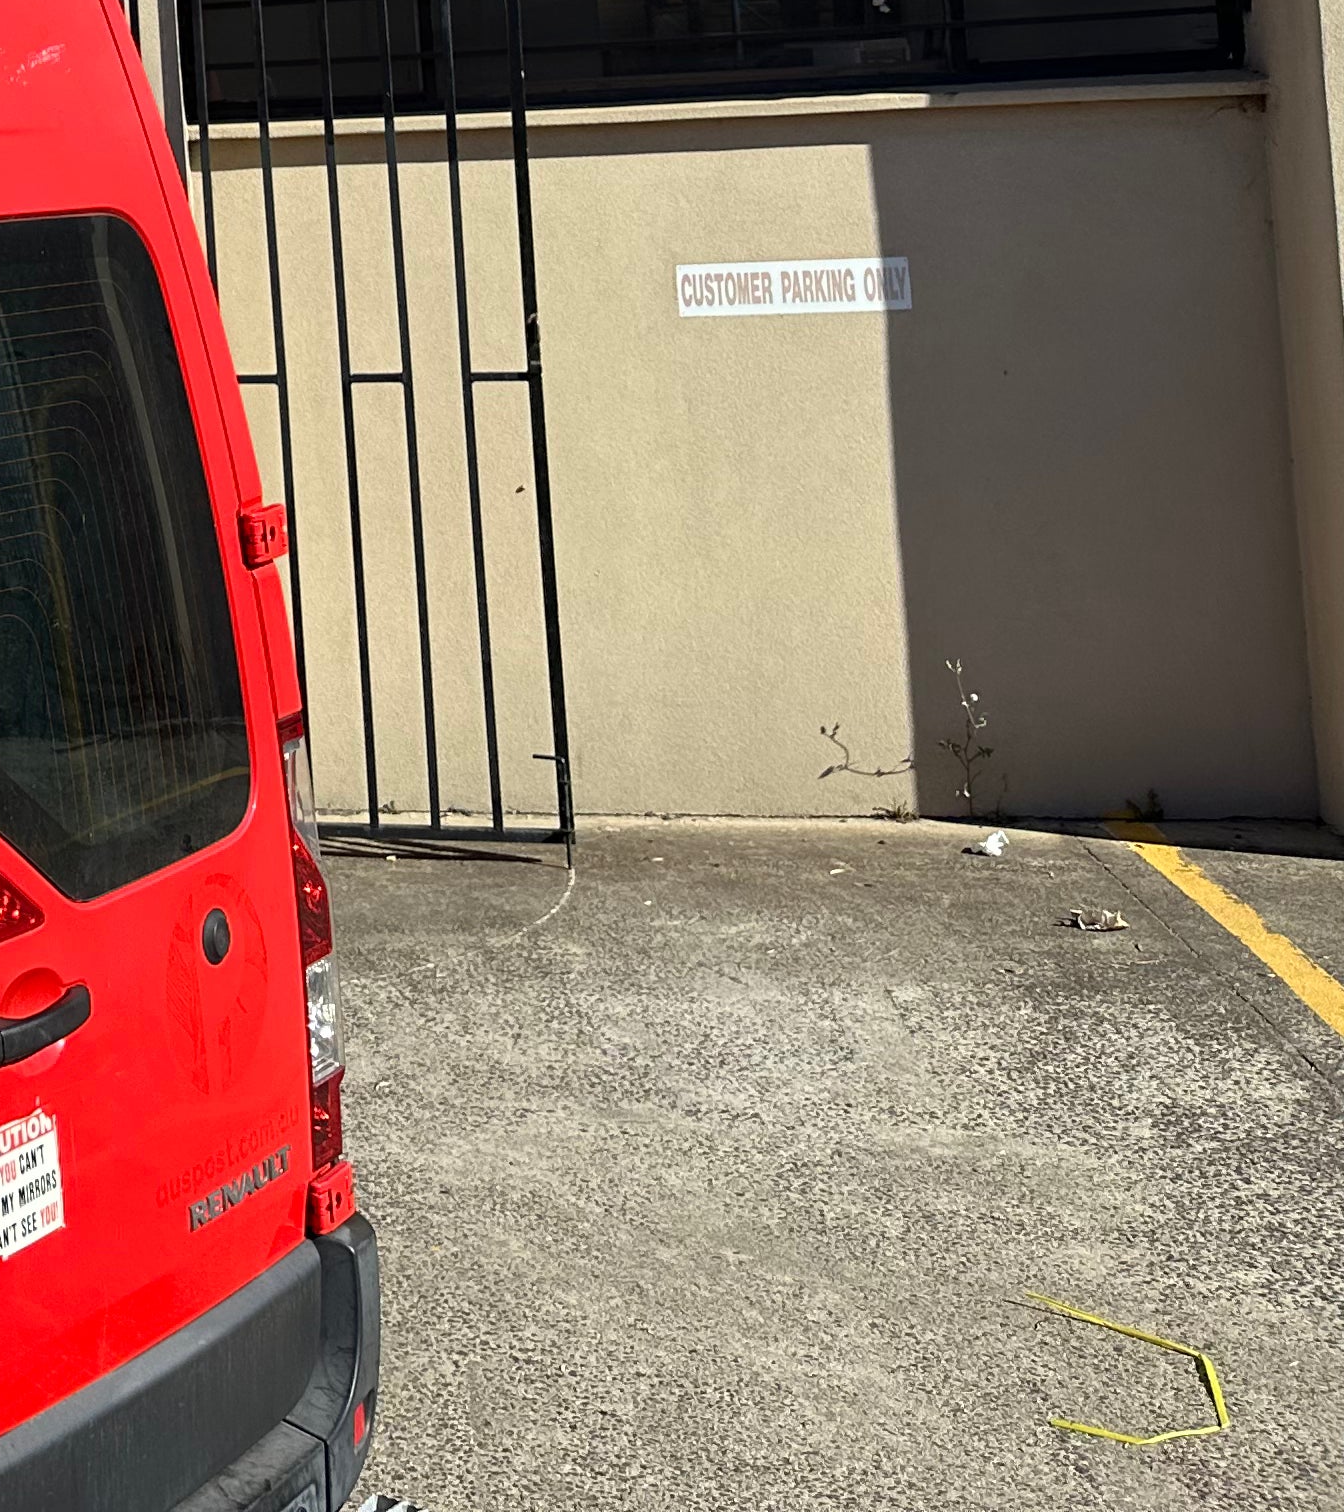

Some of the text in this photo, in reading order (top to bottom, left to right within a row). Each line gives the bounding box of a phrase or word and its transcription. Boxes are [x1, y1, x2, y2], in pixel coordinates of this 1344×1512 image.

[680, 266, 909, 307] CUSTOMER PARKING ONLY
[0, 1160, 17, 1187] YOU
[18, 1144, 45, 1175] CAN'T
[1, 1193, 15, 1216] MY
[18, 1169, 57, 1207] MIRRORS
[188, 1144, 291, 1232] RENAULT
[21, 1212, 38, 1238] SEE
